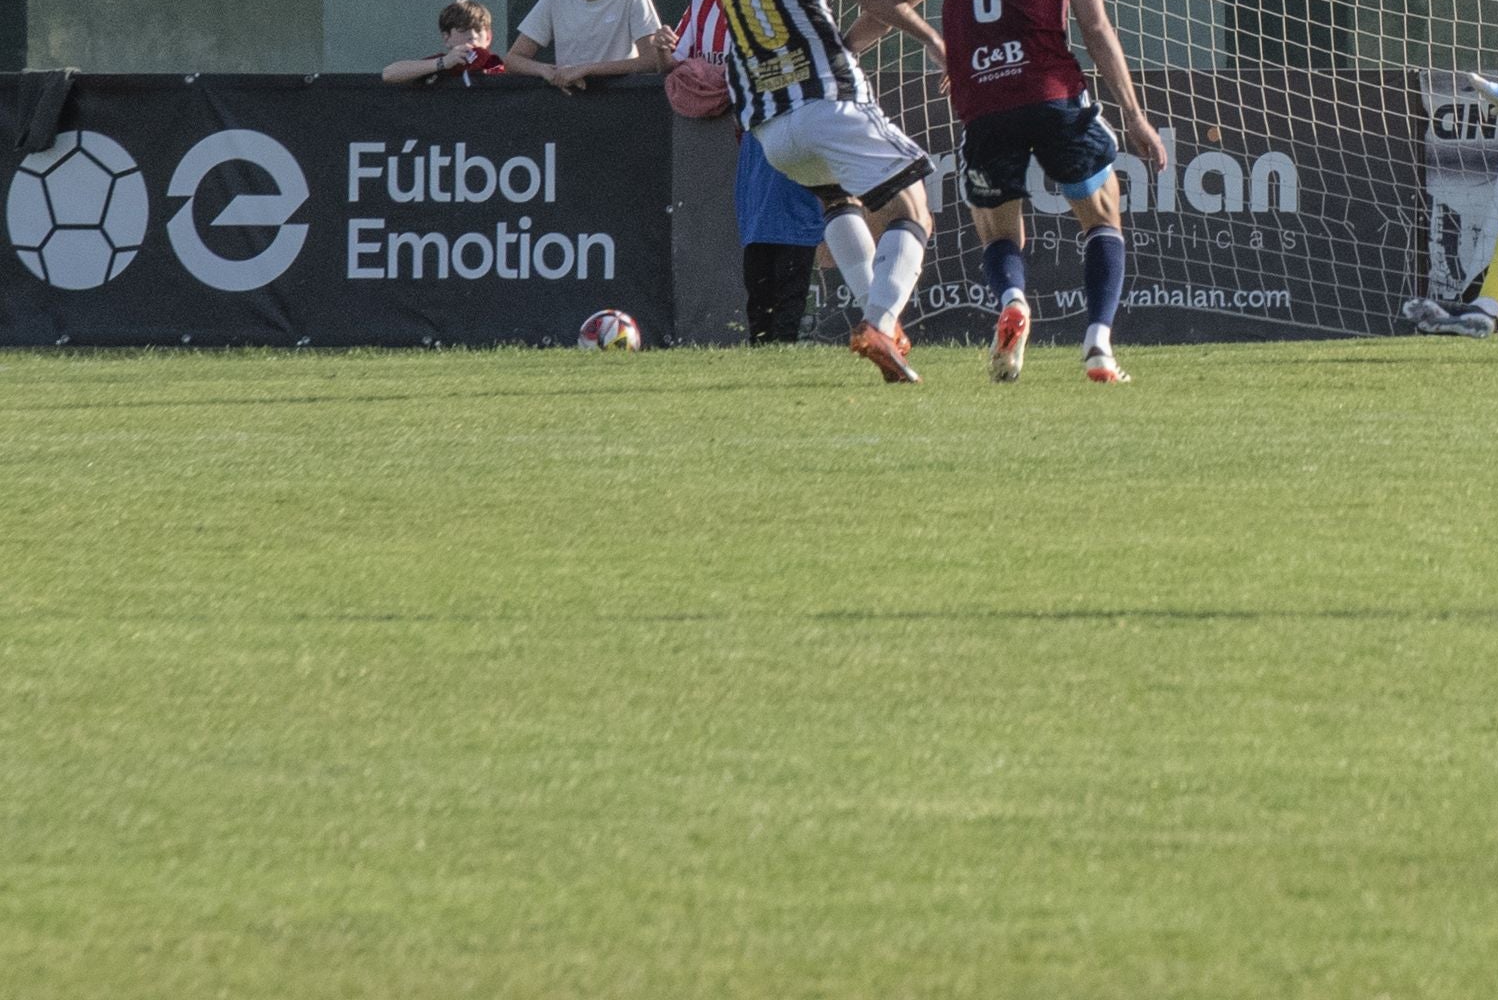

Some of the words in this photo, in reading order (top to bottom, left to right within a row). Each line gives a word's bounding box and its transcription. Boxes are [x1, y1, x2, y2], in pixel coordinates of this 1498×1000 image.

[971, 40, 1025, 71] G&B
[348, 139, 556, 203] Fútbol
[347, 216, 615, 280] Emotion
[929, 285, 960, 308] 03
[1053, 284, 1292, 309] ww.rabalan.com
